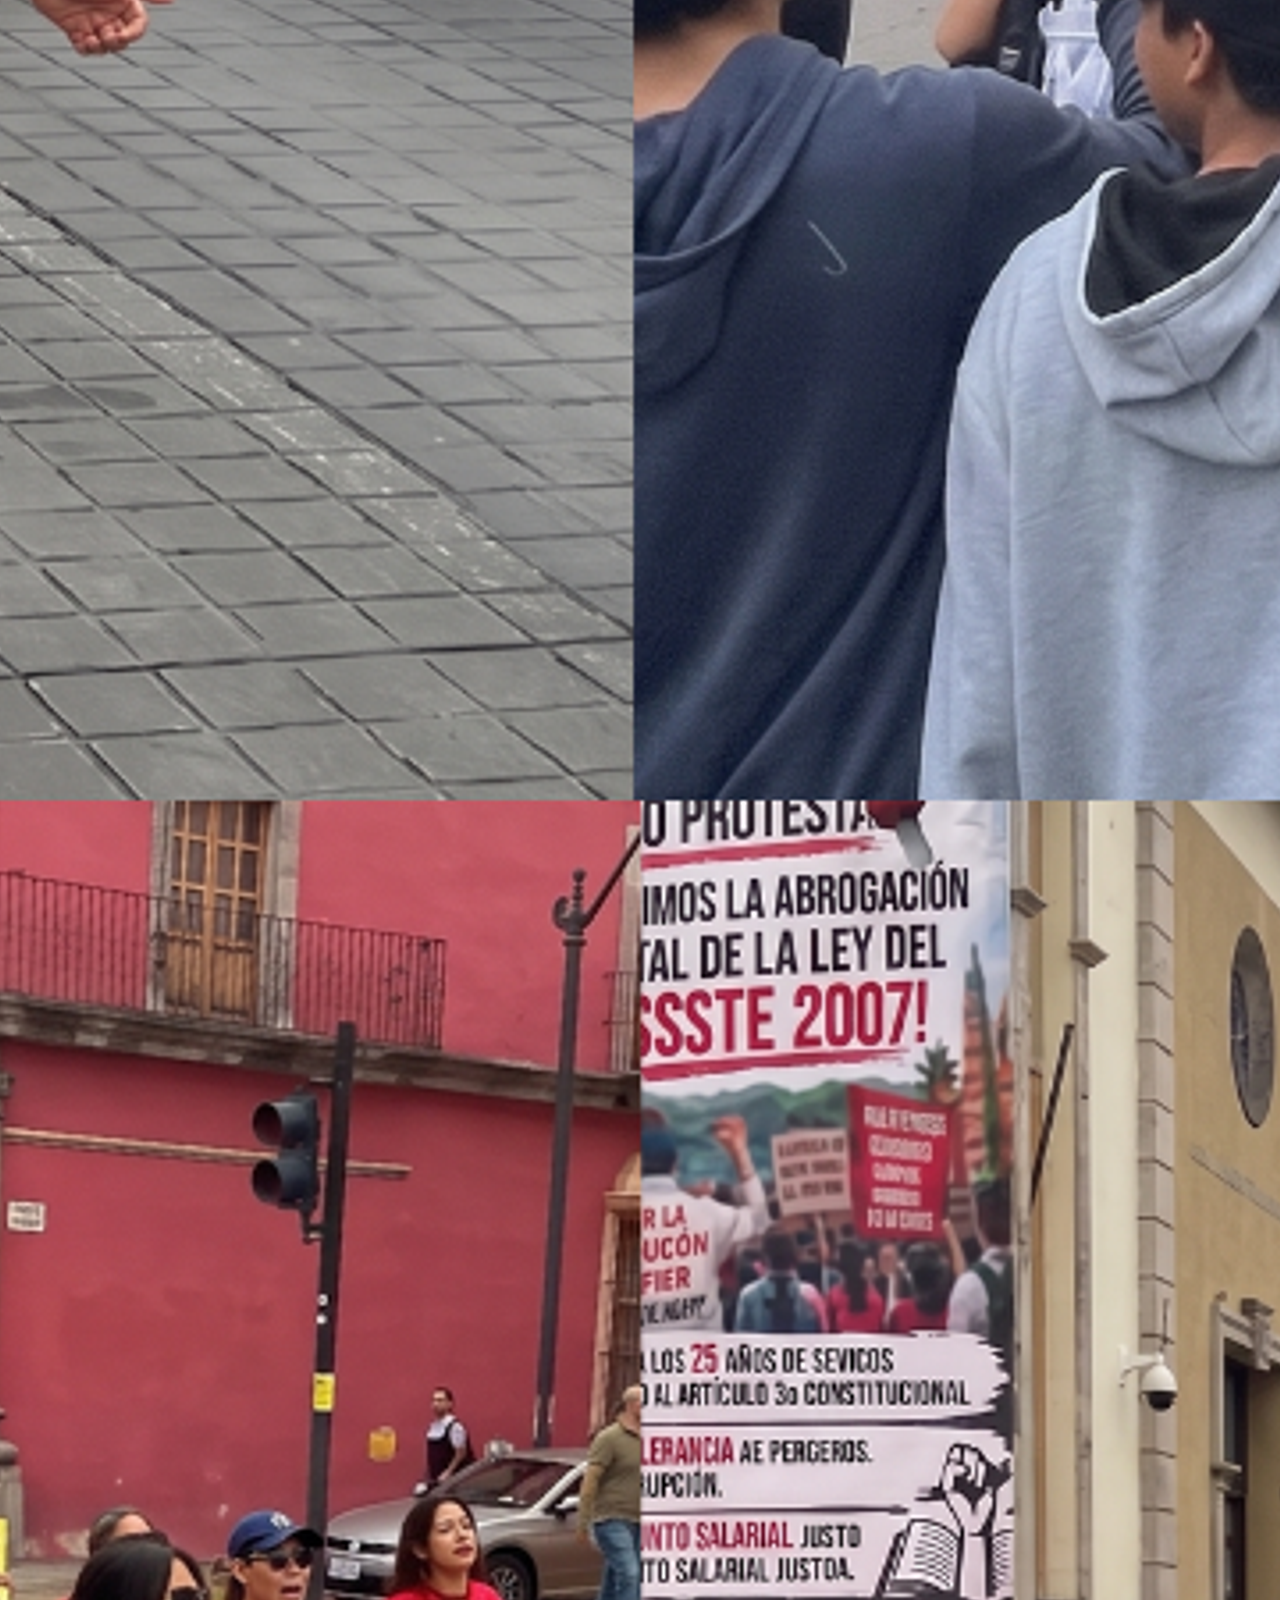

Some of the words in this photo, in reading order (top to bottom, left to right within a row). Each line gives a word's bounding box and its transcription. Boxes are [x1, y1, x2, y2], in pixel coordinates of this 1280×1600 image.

[726, 878, 765, 920] LA
[775, 860, 970, 917] ABROGACIÓN
[701, 933, 744, 979] DE
[755, 930, 798, 975] LA
[810, 926, 872, 974] LEY
[886, 923, 947, 970] DEL
[793, 980, 928, 1049] 2007!
[651, 1348, 684, 1374] LOS
[690, 1343, 718, 1373] 25
[725, 1343, 774, 1373] AÑOS
[782, 1347, 807, 1373] DE
[696, 1521, 793, 1550] SALARIAL
[800, 1524, 862, 1549] JUSTO
